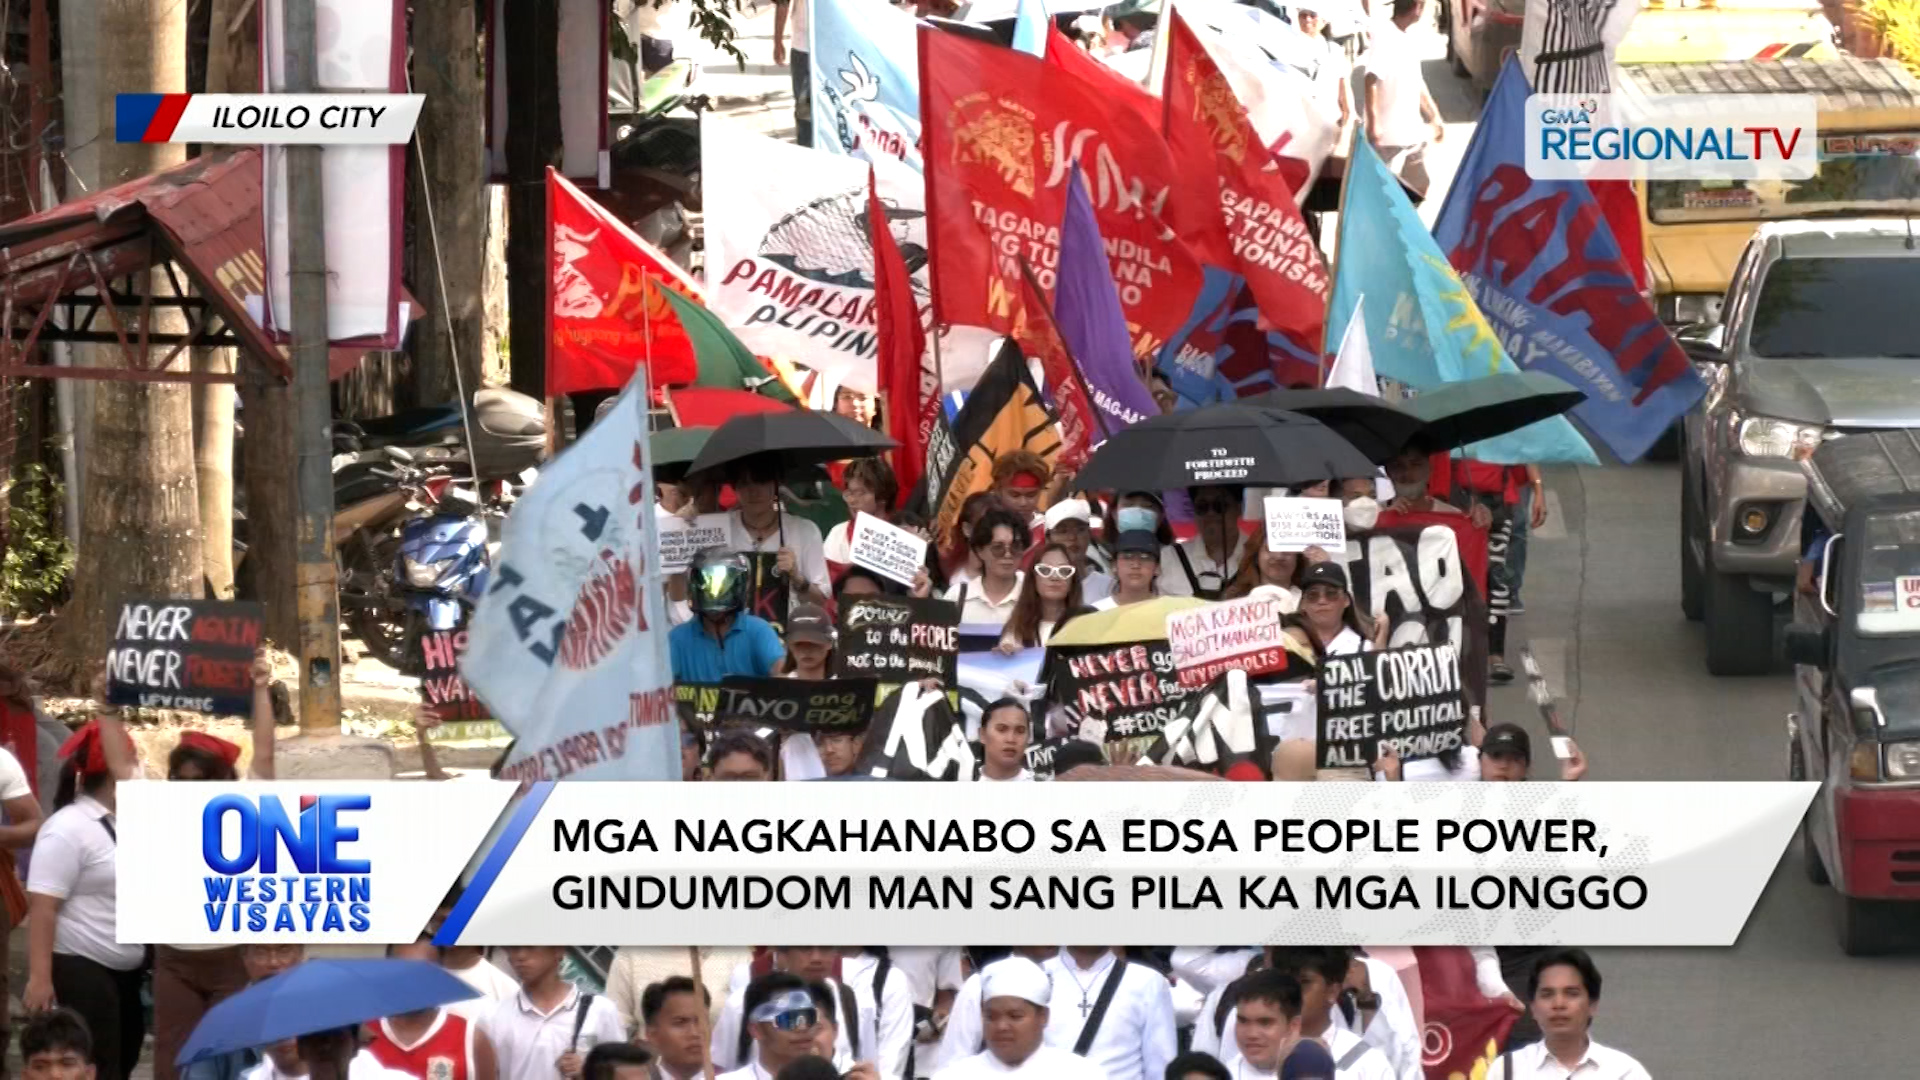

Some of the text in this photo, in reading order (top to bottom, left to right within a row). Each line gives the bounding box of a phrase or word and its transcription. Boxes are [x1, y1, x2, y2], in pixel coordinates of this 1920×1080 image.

[1241, 218, 1322, 268] TUNAY
[1210, 447, 1228, 457] TO
[115, 604, 192, 641] NEVER
[865, 628, 883, 645] to
[911, 623, 960, 651] PEOPLE
[106, 648, 182, 690] NEVER
[1068, 645, 1151, 678] NEVER
[1324, 657, 1374, 686] JAIL
[723, 688, 798, 720] TAYO
[1076, 671, 1163, 718] NEVER
[1323, 683, 1367, 710] THE
[1325, 699, 1465, 740] FREE POLITICAL
[1325, 743, 1368, 768] ALL
